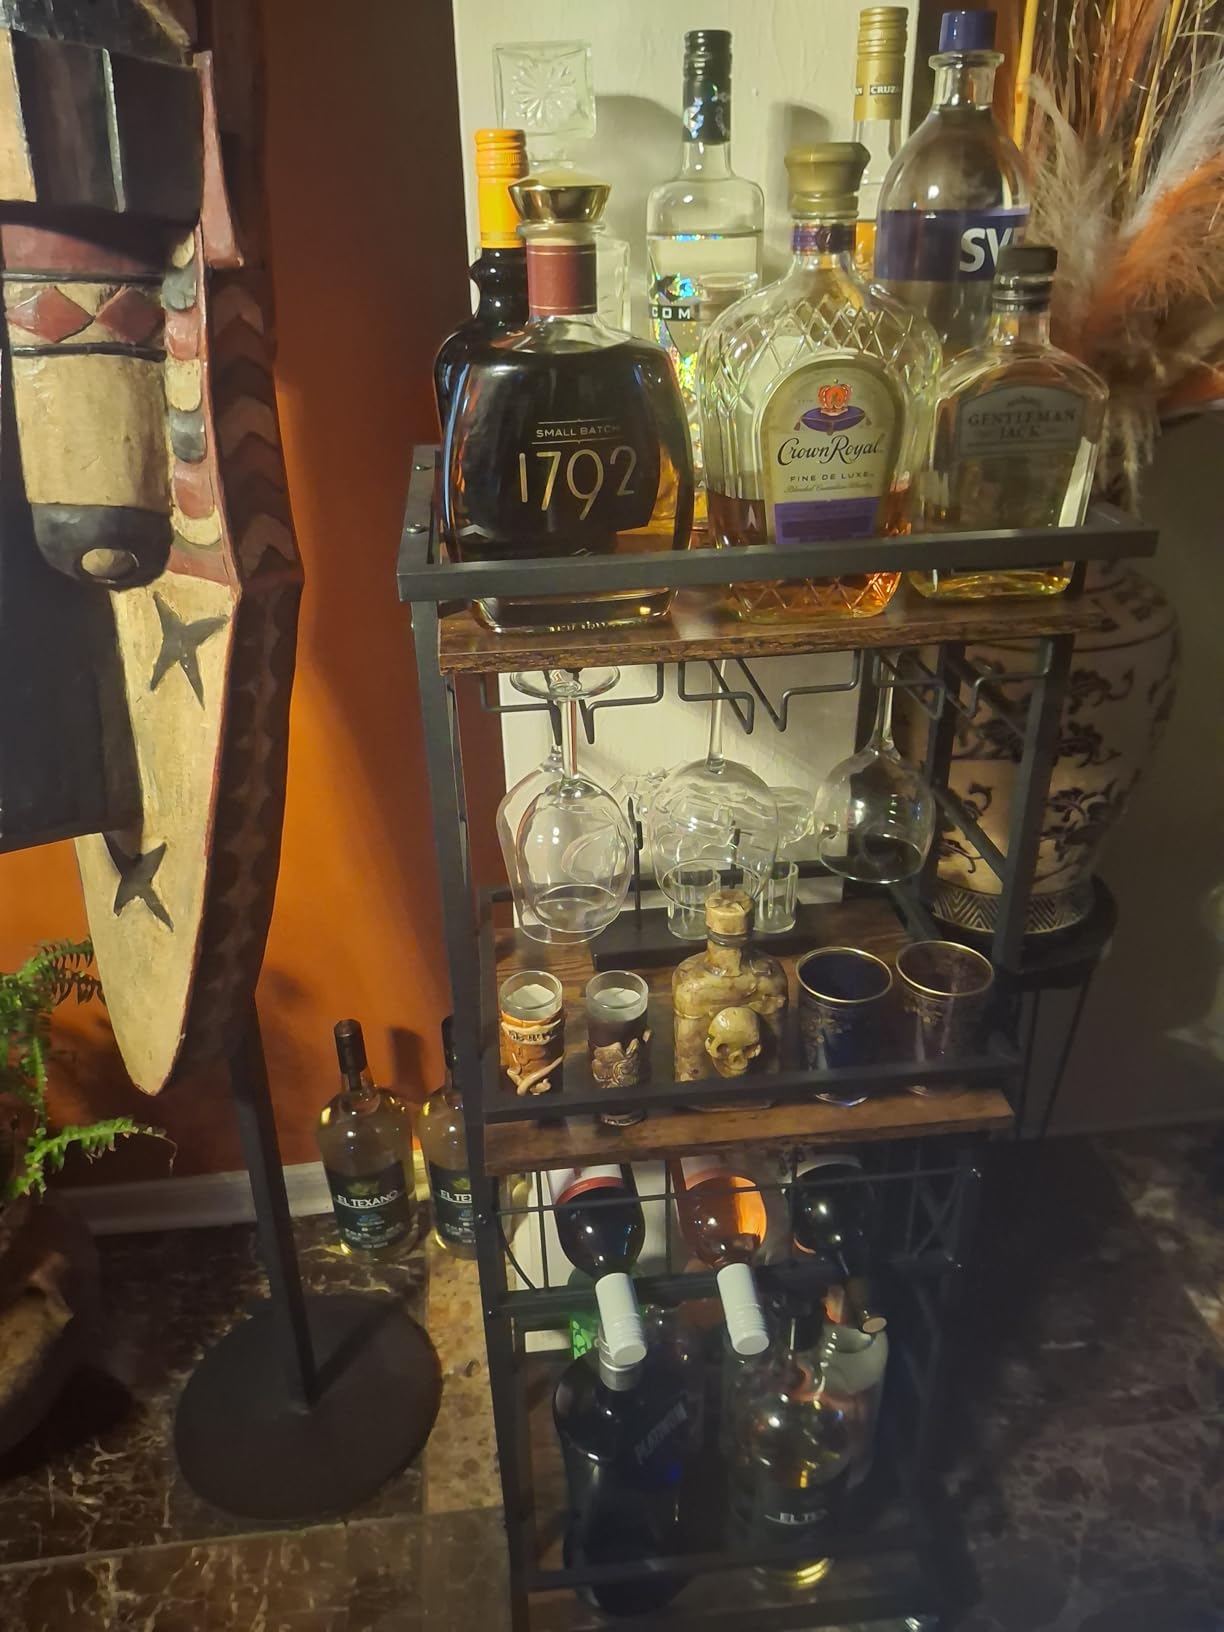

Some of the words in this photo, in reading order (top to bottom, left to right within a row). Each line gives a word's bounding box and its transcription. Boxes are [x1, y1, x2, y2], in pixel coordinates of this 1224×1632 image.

[959, 227, 1024, 273] SV
[968, 408, 1077, 426] GENTLEMAN
[535, 427, 577, 438] SMALL
[579, 424, 622, 436] BATCH
[1000, 425, 1041, 439] JACK
[777, 437, 830, 466] Crown
[819, 434, 886, 466] Royal
[519, 445, 637, 521] 1792
[790, 474, 817, 483] FINE
[821, 472, 837, 481] DE
[841, 471, 869, 480] LUXE
[337, 1194, 350, 1207] EL
[350, 1190, 398, 1208] TEXANO
[440, 1189, 454, 1202] EL
